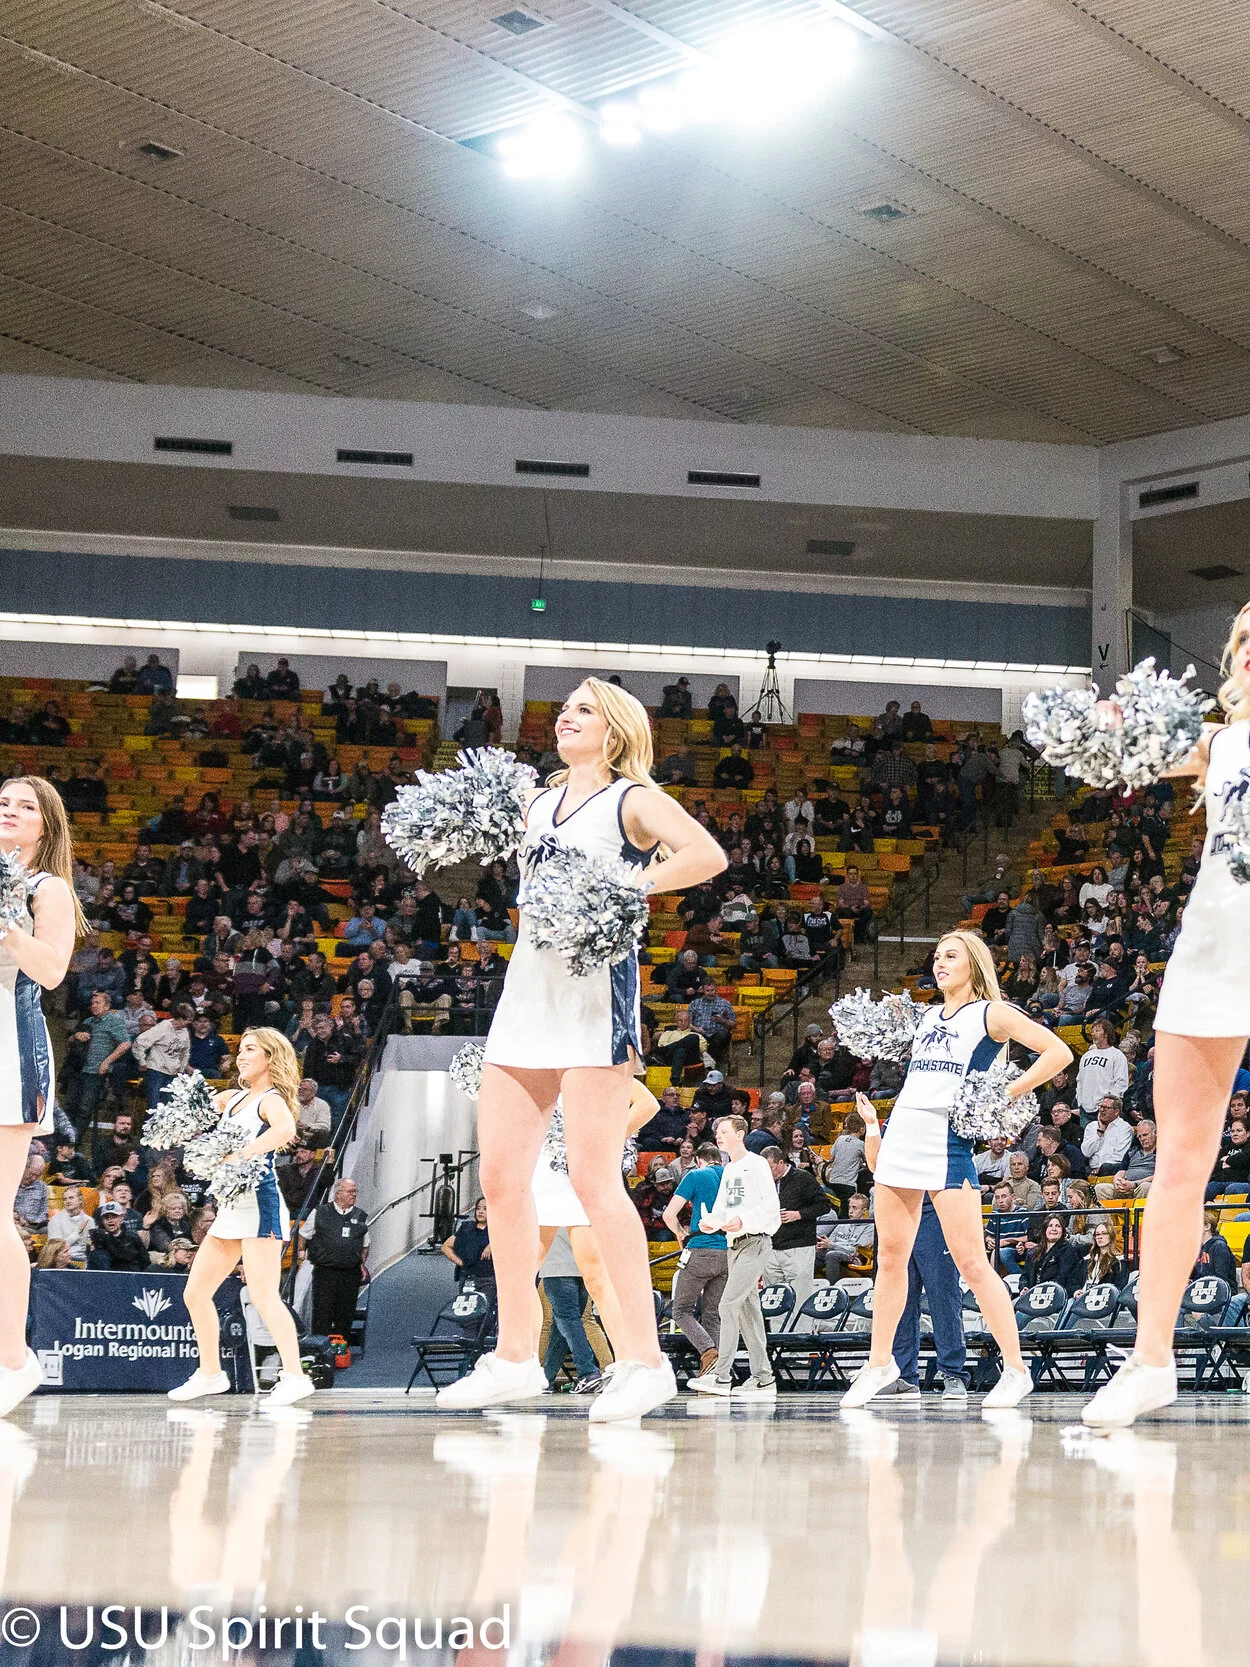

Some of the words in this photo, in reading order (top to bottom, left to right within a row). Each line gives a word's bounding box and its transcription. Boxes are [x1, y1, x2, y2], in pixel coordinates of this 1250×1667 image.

[1098, 644, 1109, 661] V
[931, 1060, 964, 1076] STATE
[1083, 1056, 1108, 1068] USU
[54, 1340, 104, 1360] Logan
[108, 1341, 175, 1361] Regional
